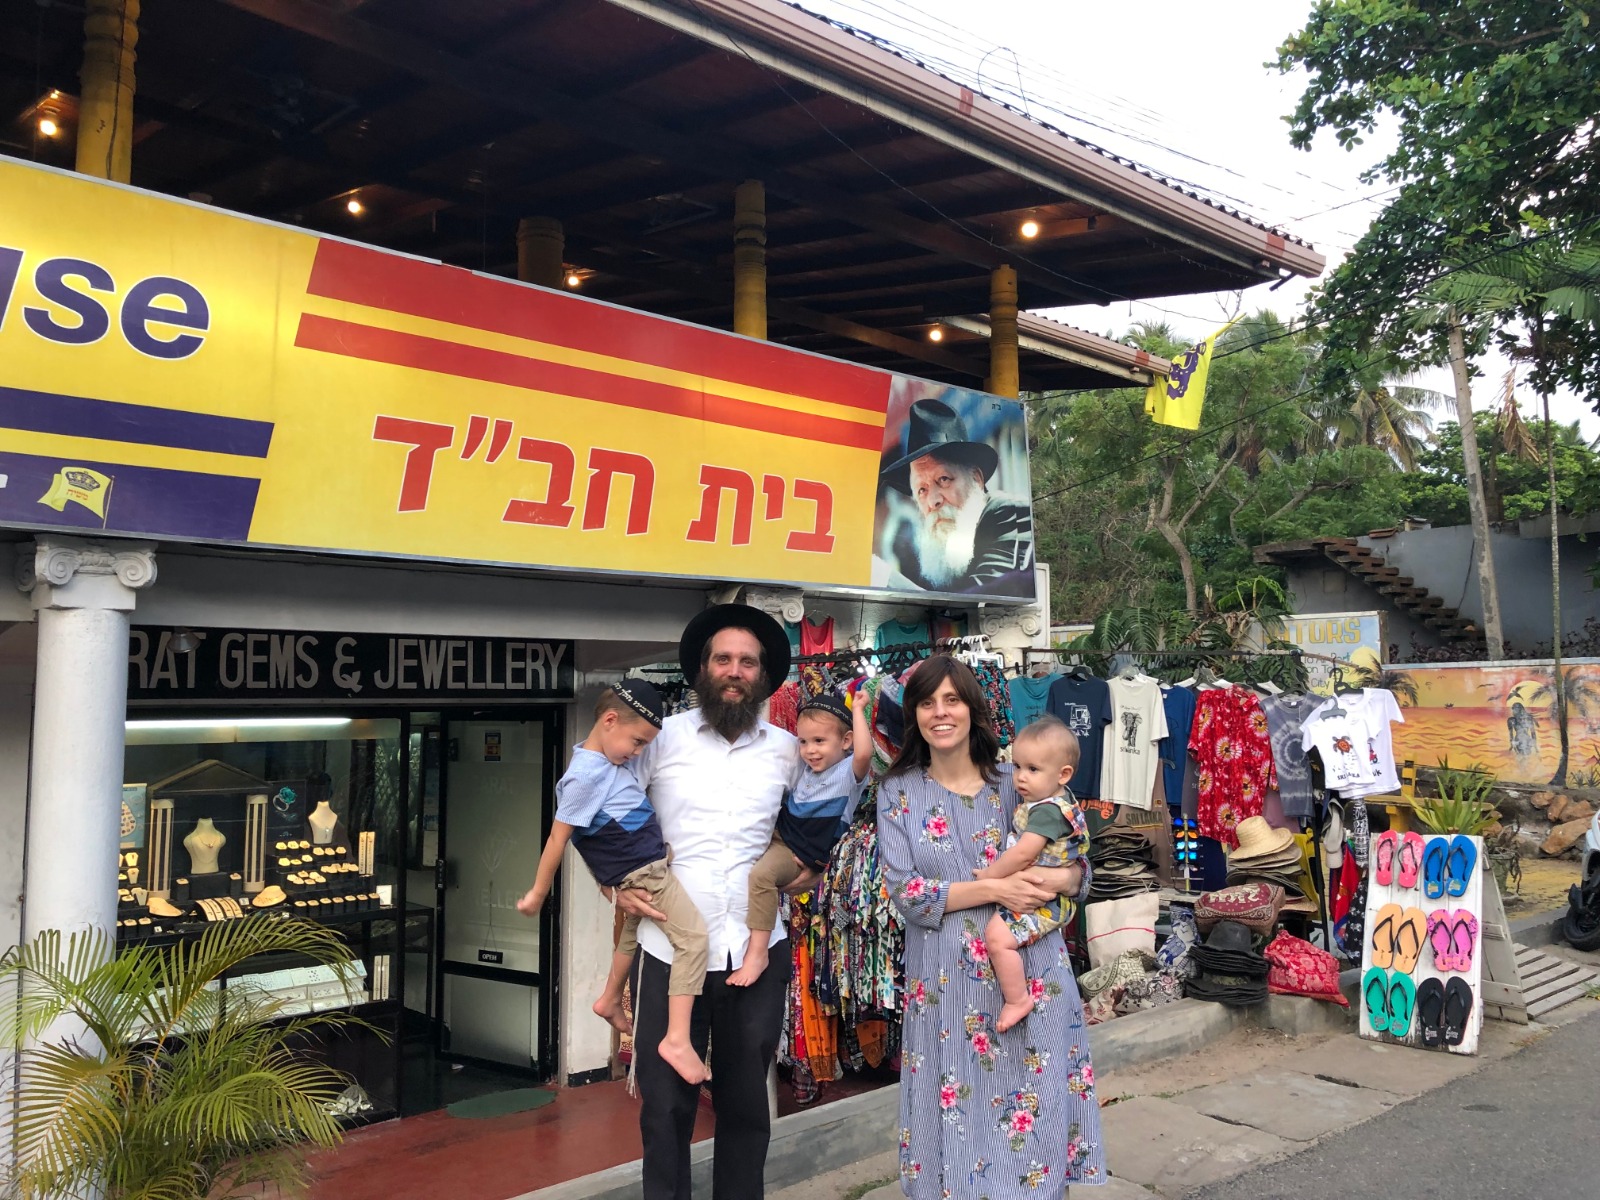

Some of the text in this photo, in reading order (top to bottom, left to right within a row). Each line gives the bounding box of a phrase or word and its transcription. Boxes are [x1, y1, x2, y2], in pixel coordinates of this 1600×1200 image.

[372, 414, 835, 554] בית חב"ד
[219, 632, 319, 689] GEMS
[332, 635, 363, 698] &
[374, 638, 567, 690] JEWELLERY
[1311, 677, 1330, 690] City
[1126, 812, 1140, 826] SRI
[481, 953, 497, 961] OPEN
